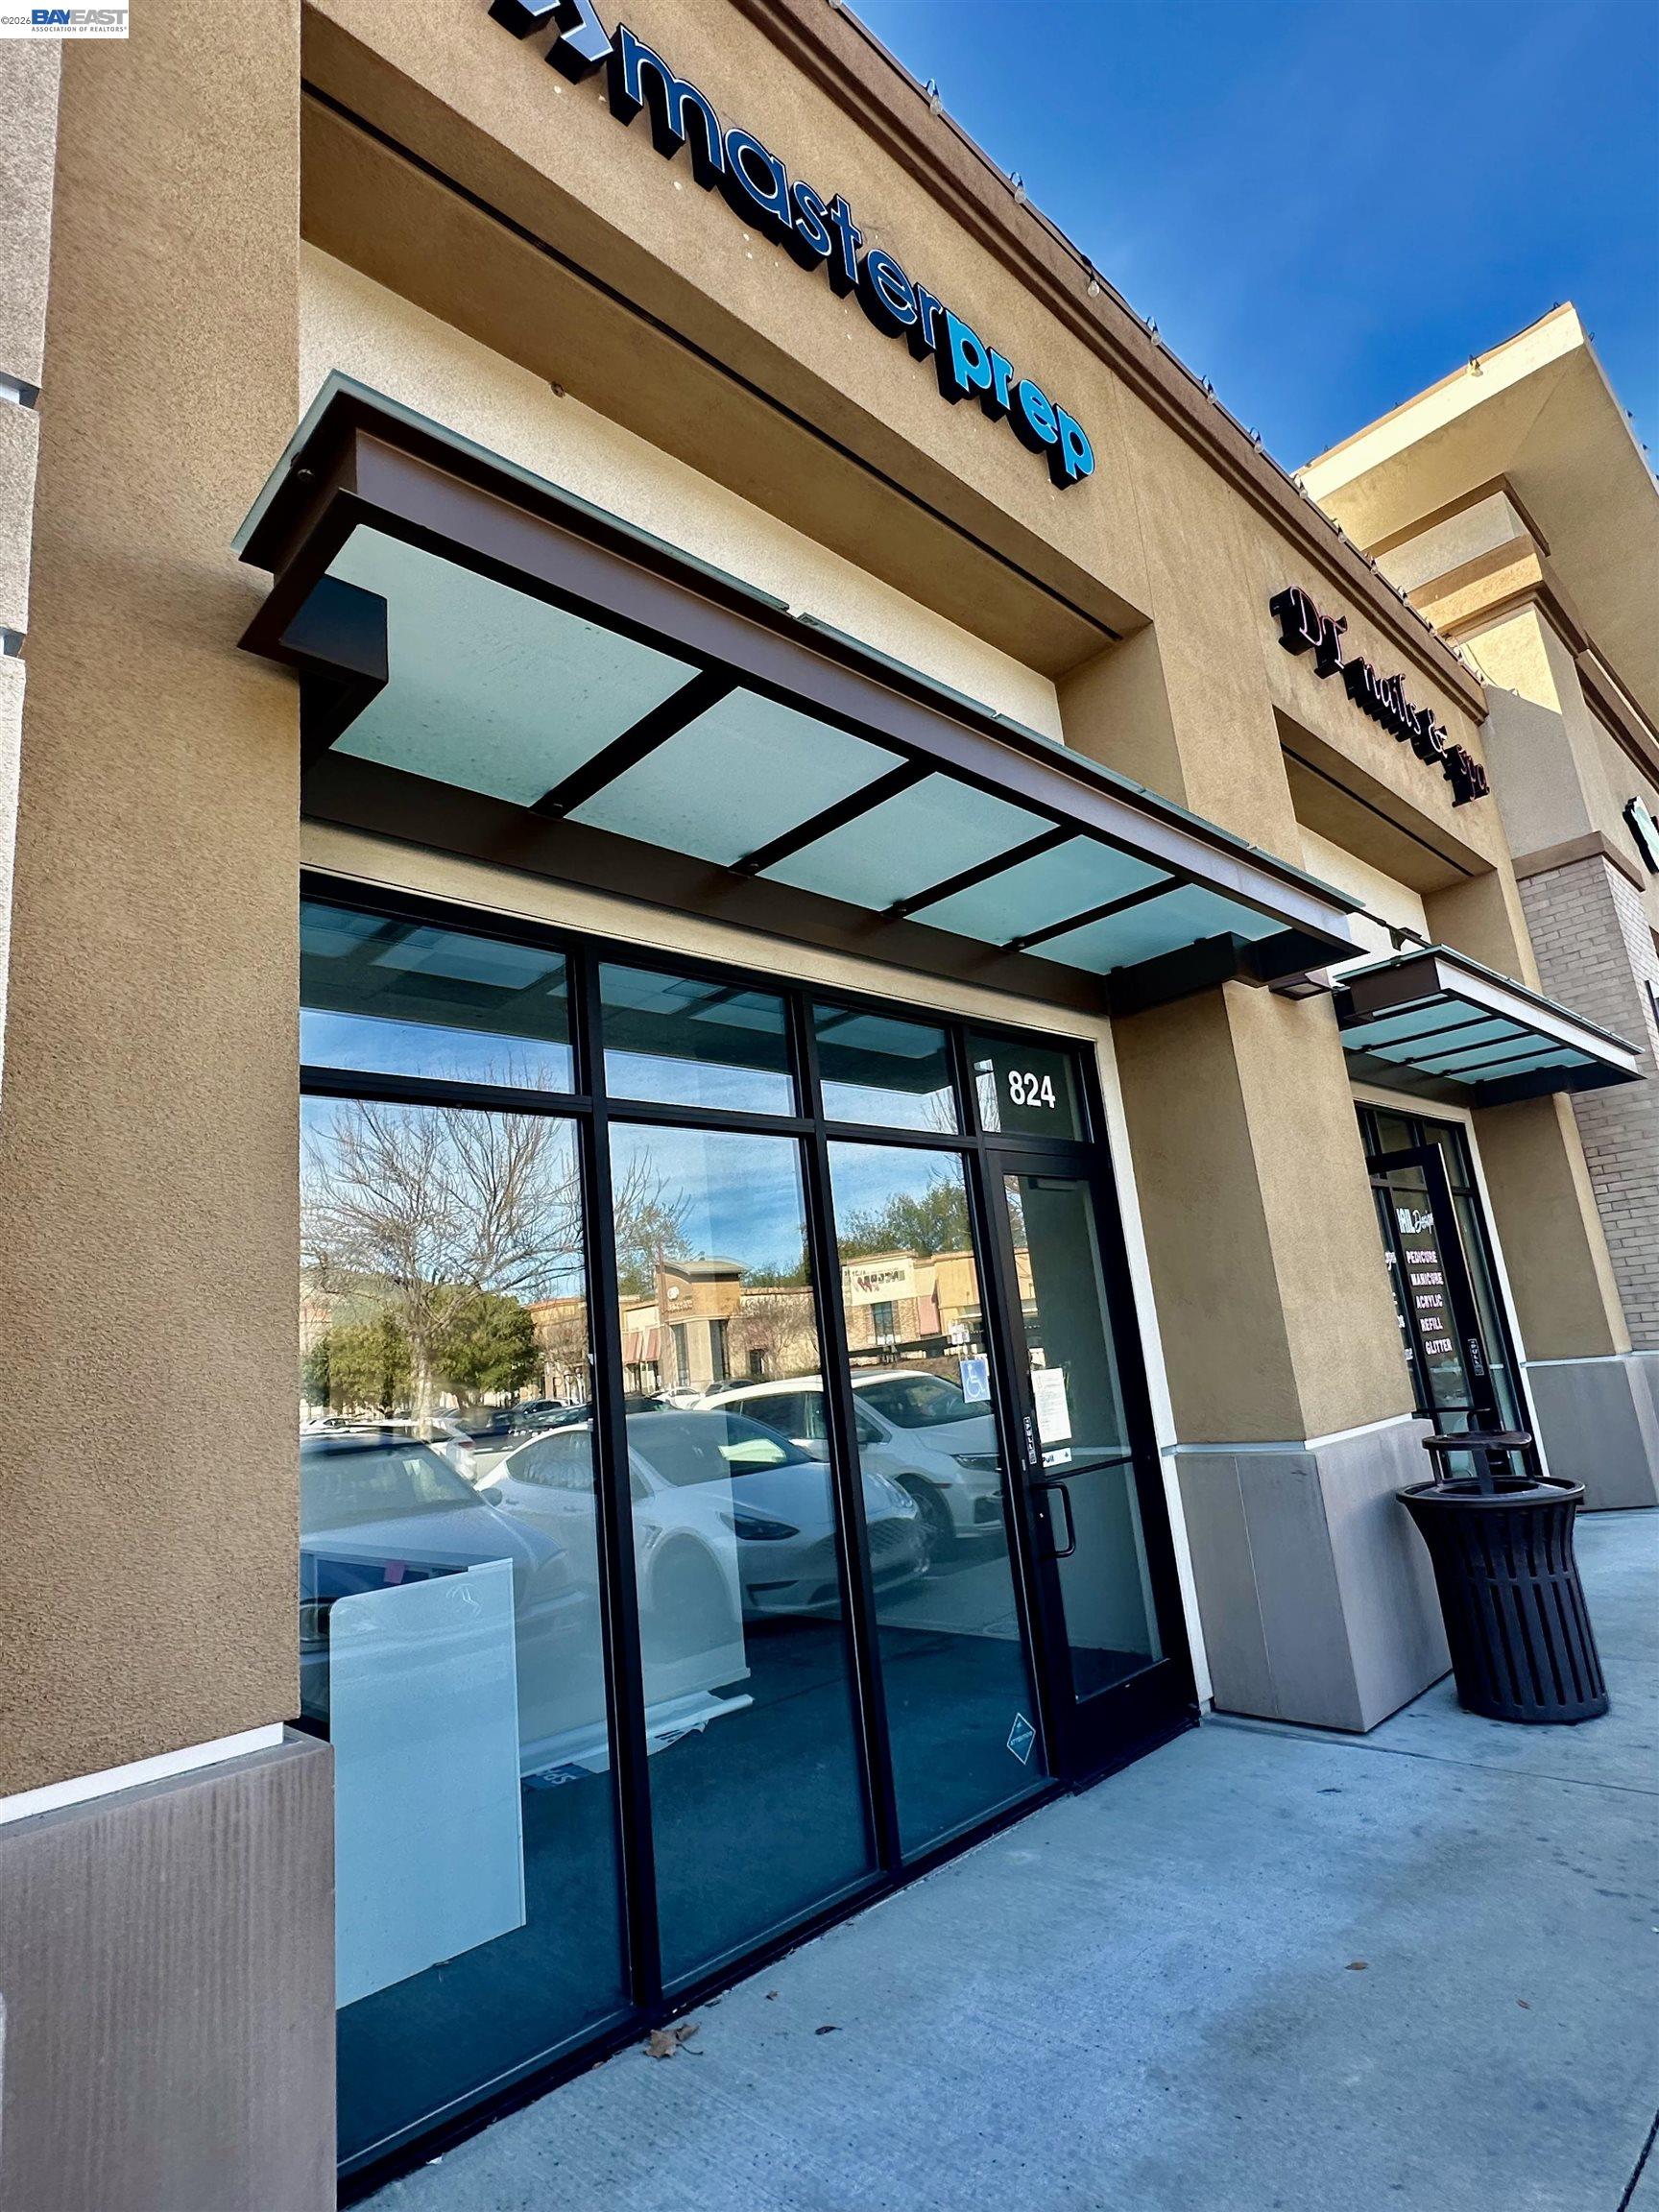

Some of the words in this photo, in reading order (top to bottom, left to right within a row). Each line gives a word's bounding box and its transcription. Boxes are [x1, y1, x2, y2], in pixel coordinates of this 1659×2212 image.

[614, 23, 1095, 483] masterprep
[1008, 1070, 1056, 1109] 824
[1406, 1250, 1438, 1264] PEDICURE
[1410, 1272, 1444, 1286] MANICURE
[1415, 1293, 1443, 1309] ACRYLIC
[1420, 1316, 1444, 1333] REFILL
[1425, 1337, 1454, 1356] GLITTER
